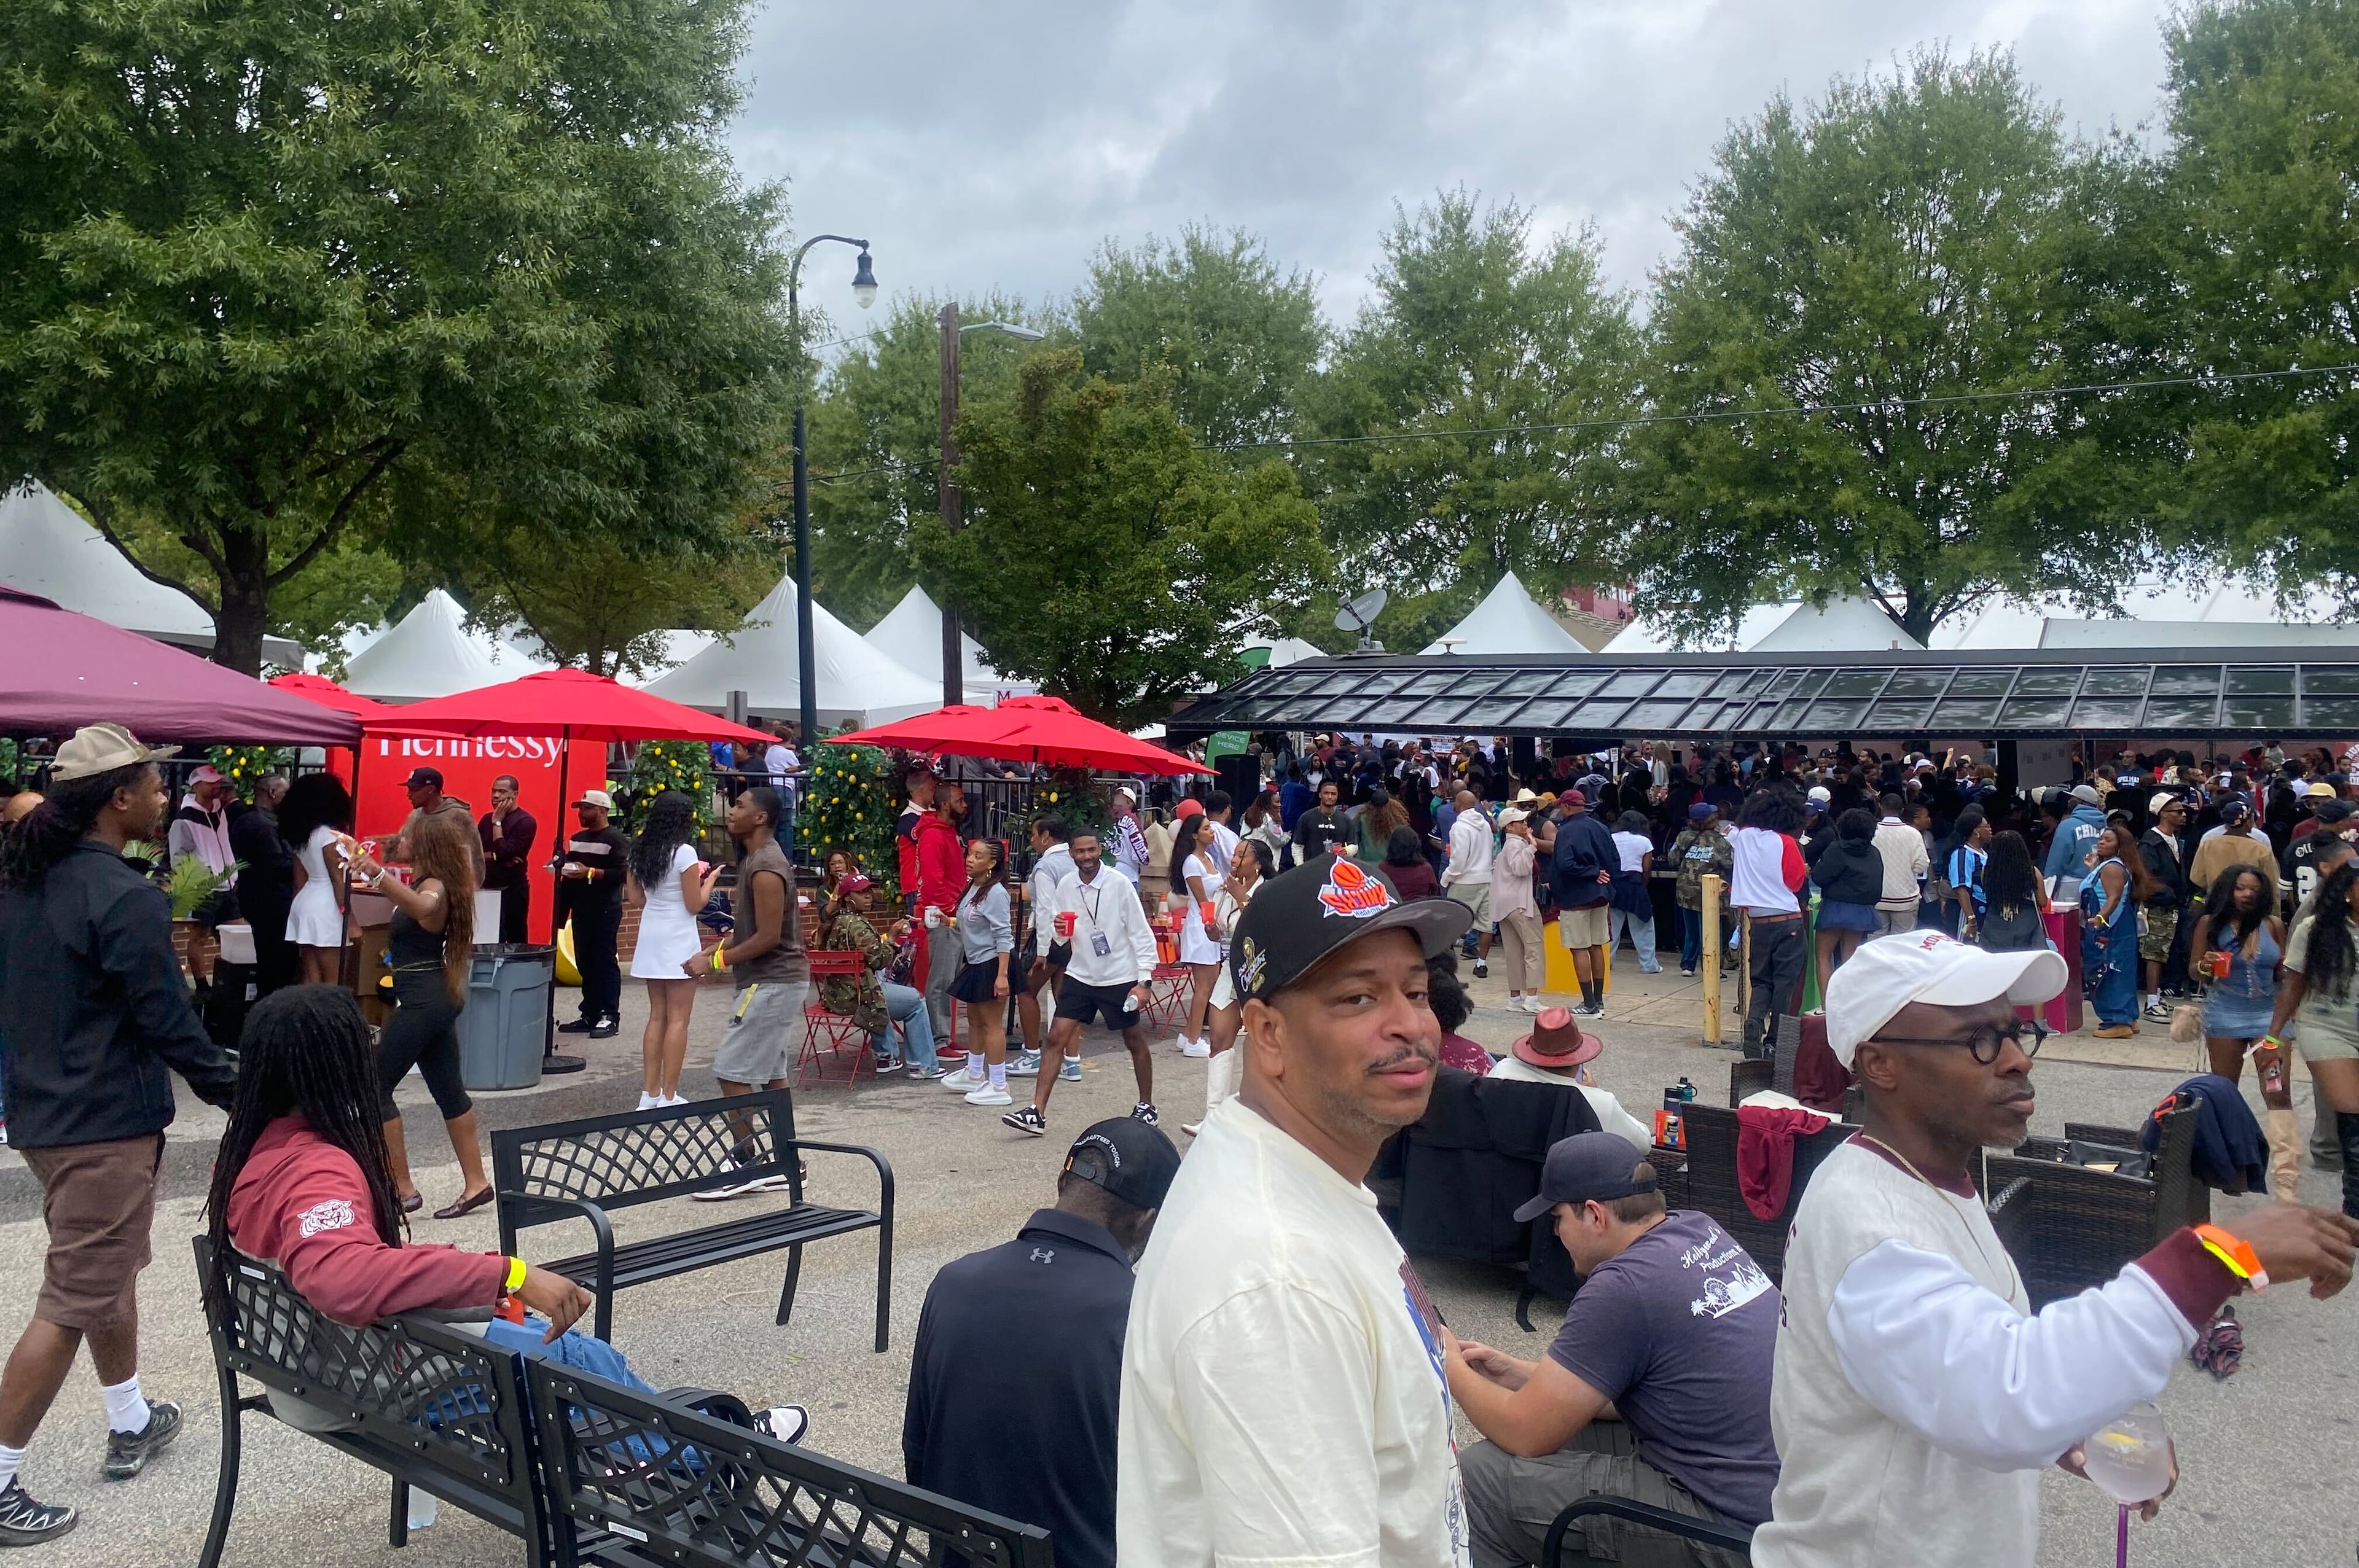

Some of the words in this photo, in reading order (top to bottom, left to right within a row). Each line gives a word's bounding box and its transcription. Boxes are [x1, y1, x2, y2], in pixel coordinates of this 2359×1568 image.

[1215, 731, 1246, 743] DEVICE
[1218, 741, 1240, 751] HERE
[1321, 883, 1388, 914] KNICKS
